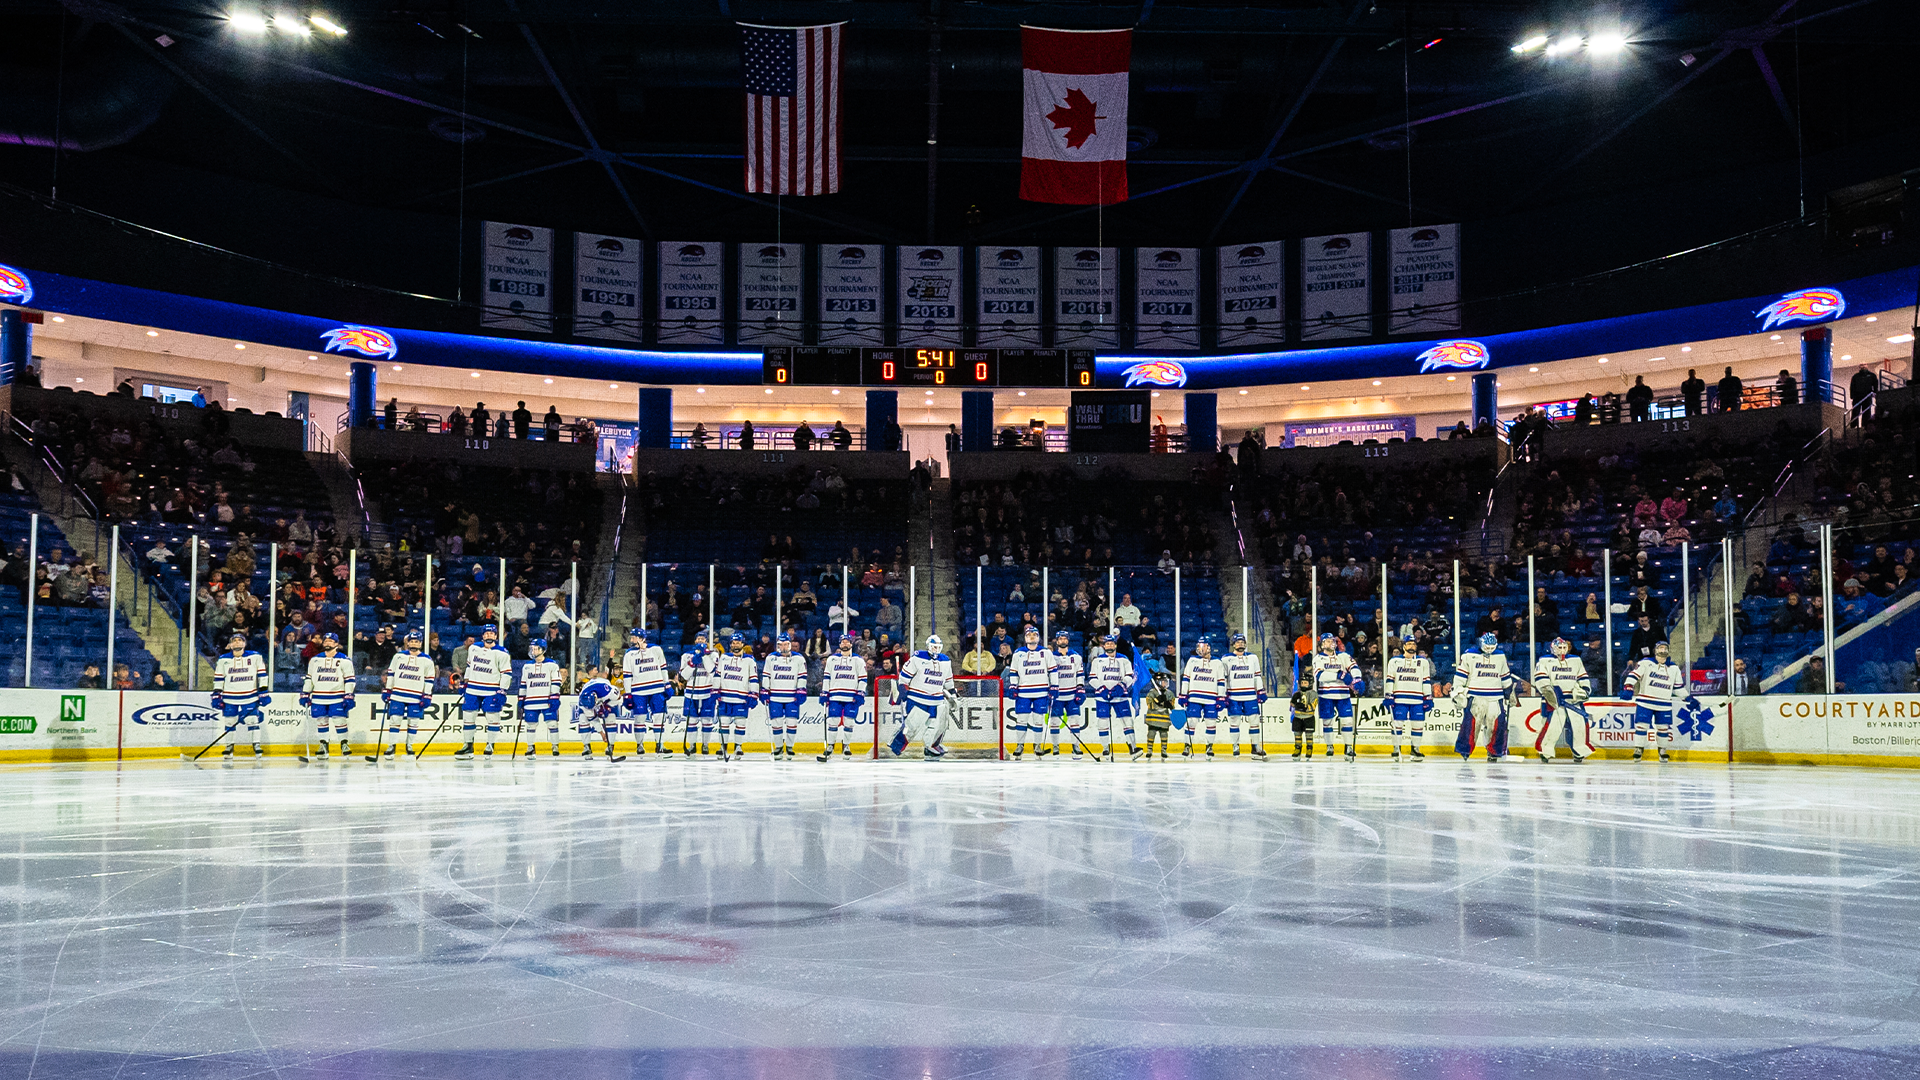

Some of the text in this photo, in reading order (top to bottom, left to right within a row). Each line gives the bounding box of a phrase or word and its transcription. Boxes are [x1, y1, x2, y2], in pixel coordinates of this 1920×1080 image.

[506, 256, 530, 265] NCAA
[488, 264, 548, 277] TOURNAMENT
[597, 267, 620, 276] NCAA
[1394, 261, 1454, 273] CHAMPIONS
[580, 275, 638, 288] TOURNAMENT
[680, 273, 702, 281] NCAA
[1076, 278, 1098, 286] NCAA
[1239, 274, 1262, 282] NCAA
[497, 280, 538, 295] 1988
[663, 283, 718, 291] TOURNAMENT
[744, 284, 798, 293] TOURNAMENT
[982, 287, 1037, 295] TOURNAMENT
[1059, 288, 1114, 296] TOURNAMENT
[1223, 282, 1278, 294] TOURNAMENT
[589, 290, 628, 305] 1994
[672, 298, 710, 309] 1996
[752, 298, 790, 310] 2012
[832, 300, 870, 311] 2013
[991, 302, 1028, 313] 2014
[1068, 302, 1106, 314] 2016
[1149, 303, 1186, 314] 2017
[1232, 298, 1270, 311] 2022
[911, 306, 949, 317] 2013
[872, 352, 894, 360] HOME
[917, 350, 954, 368] 5:41
[964, 353, 988, 361] GUEST
[777, 369, 787, 383] 0
[883, 362, 895, 380] 0
[976, 362, 988, 381] 0
[936, 370, 945, 384] 0
[1080, 371, 1090, 385] 0
[1075, 405, 1104, 414] WALK
[1075, 414, 1100, 423] THRU
[1346, 424, 1394, 432] BASKETBALL
[1661, 420, 1690, 433] 113
[464, 439, 489, 450] 110
[1365, 447, 1388, 458] 113
[763, 454, 784, 463] 111
[1076, 456, 1098, 465] 112
[1779, 702, 1920, 718] COURTYARD
[152, 713, 220, 721] CLARK
[855, 712, 904, 725] ULTR
[1, 719, 32, 731] C.COM
[268, 719, 302, 728] Agency
[1597, 732, 1636, 741] TRINIT
